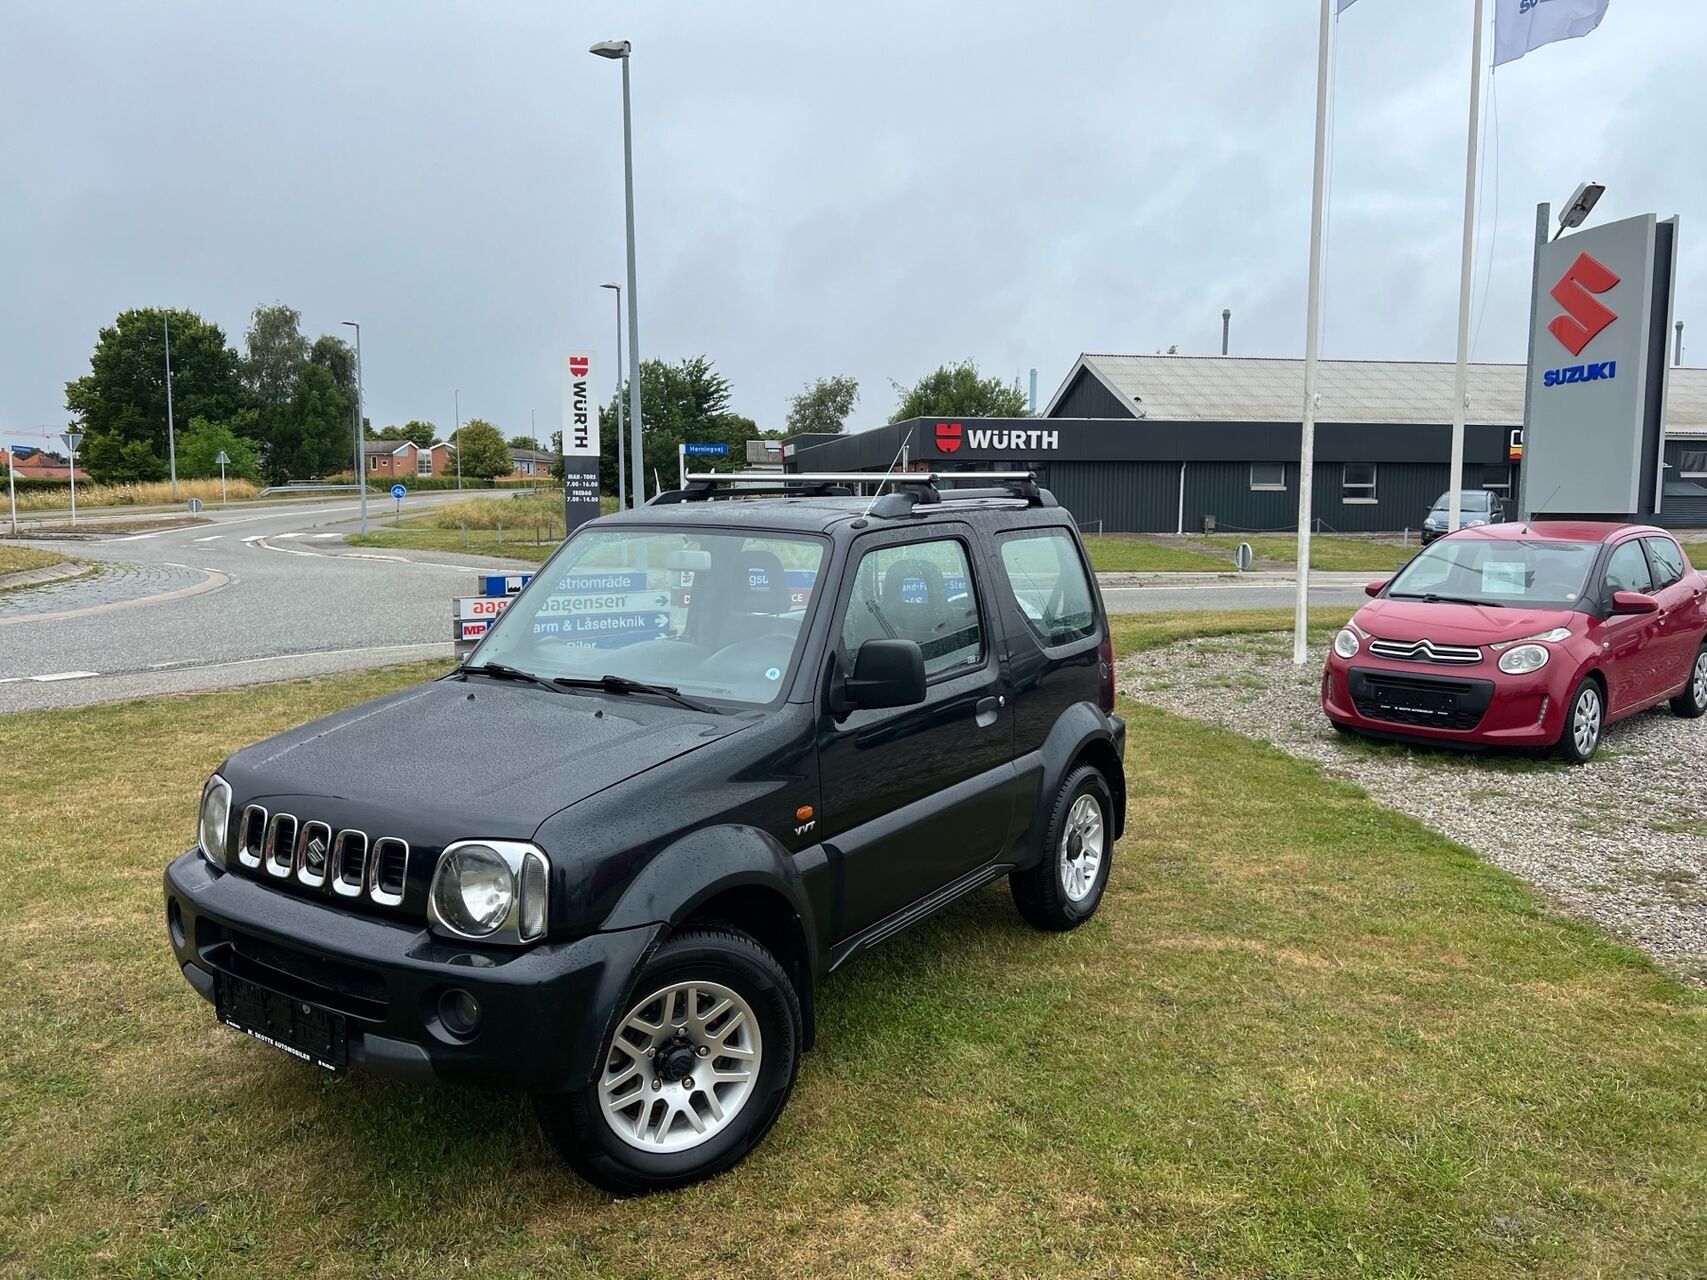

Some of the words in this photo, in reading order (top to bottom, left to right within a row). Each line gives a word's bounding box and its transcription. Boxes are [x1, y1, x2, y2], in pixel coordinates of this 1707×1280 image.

[1544, 361, 1616, 387] SUZUKI
[573, 381, 588, 448] WÜRTH
[967, 429, 1058, 450] WÜRTH
[690, 446, 724, 454] Herningvej
[555, 575, 632, 590] striområde
[540, 595, 626, 613] aagensen
[791, 594, 804, 602] CE
[473, 601, 508, 614] aag
[463, 625, 486, 636] MP
[533, 621, 559, 633] arm
[562, 619, 572, 632] &
[577, 616, 646, 632] Låseteknik
[274, 1040, 311, 1061] AUTOMOBILER
